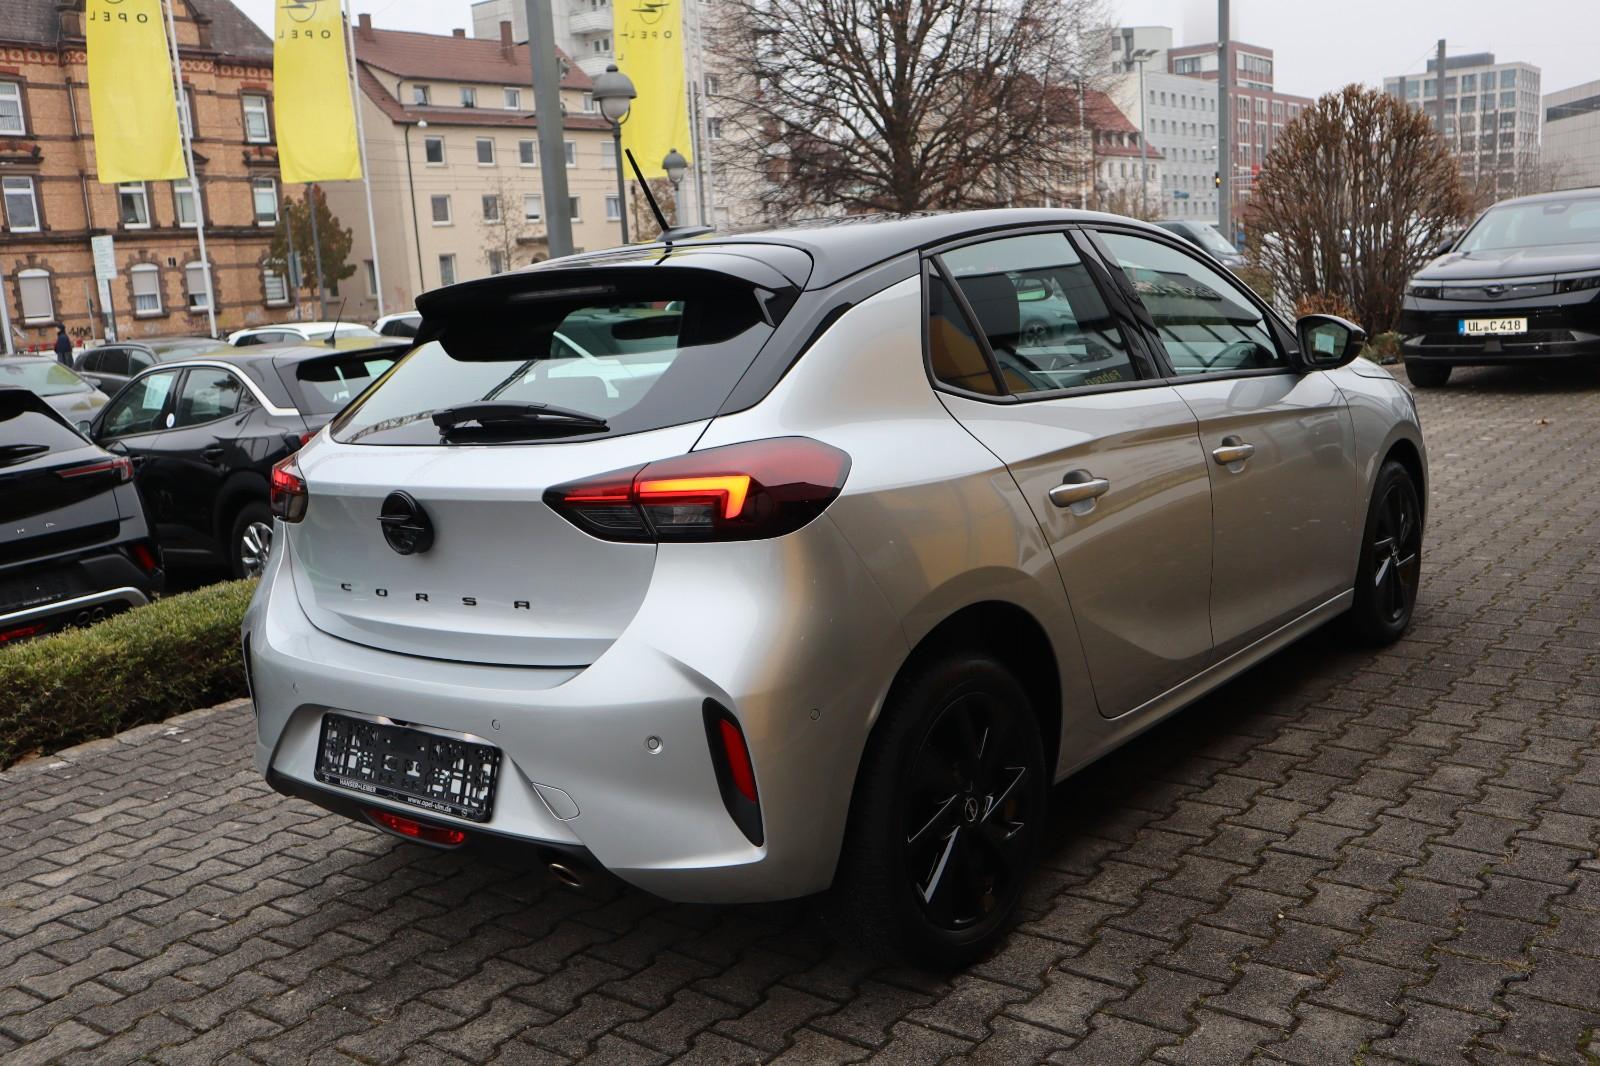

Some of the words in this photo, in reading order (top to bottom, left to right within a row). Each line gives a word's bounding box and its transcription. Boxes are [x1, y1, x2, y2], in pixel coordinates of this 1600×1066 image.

[1468, 320, 1483, 332] UL
[1490, 320, 1497, 331] C
[1500, 320, 1521, 330] 418
[340, 583, 530, 610] CORSA
